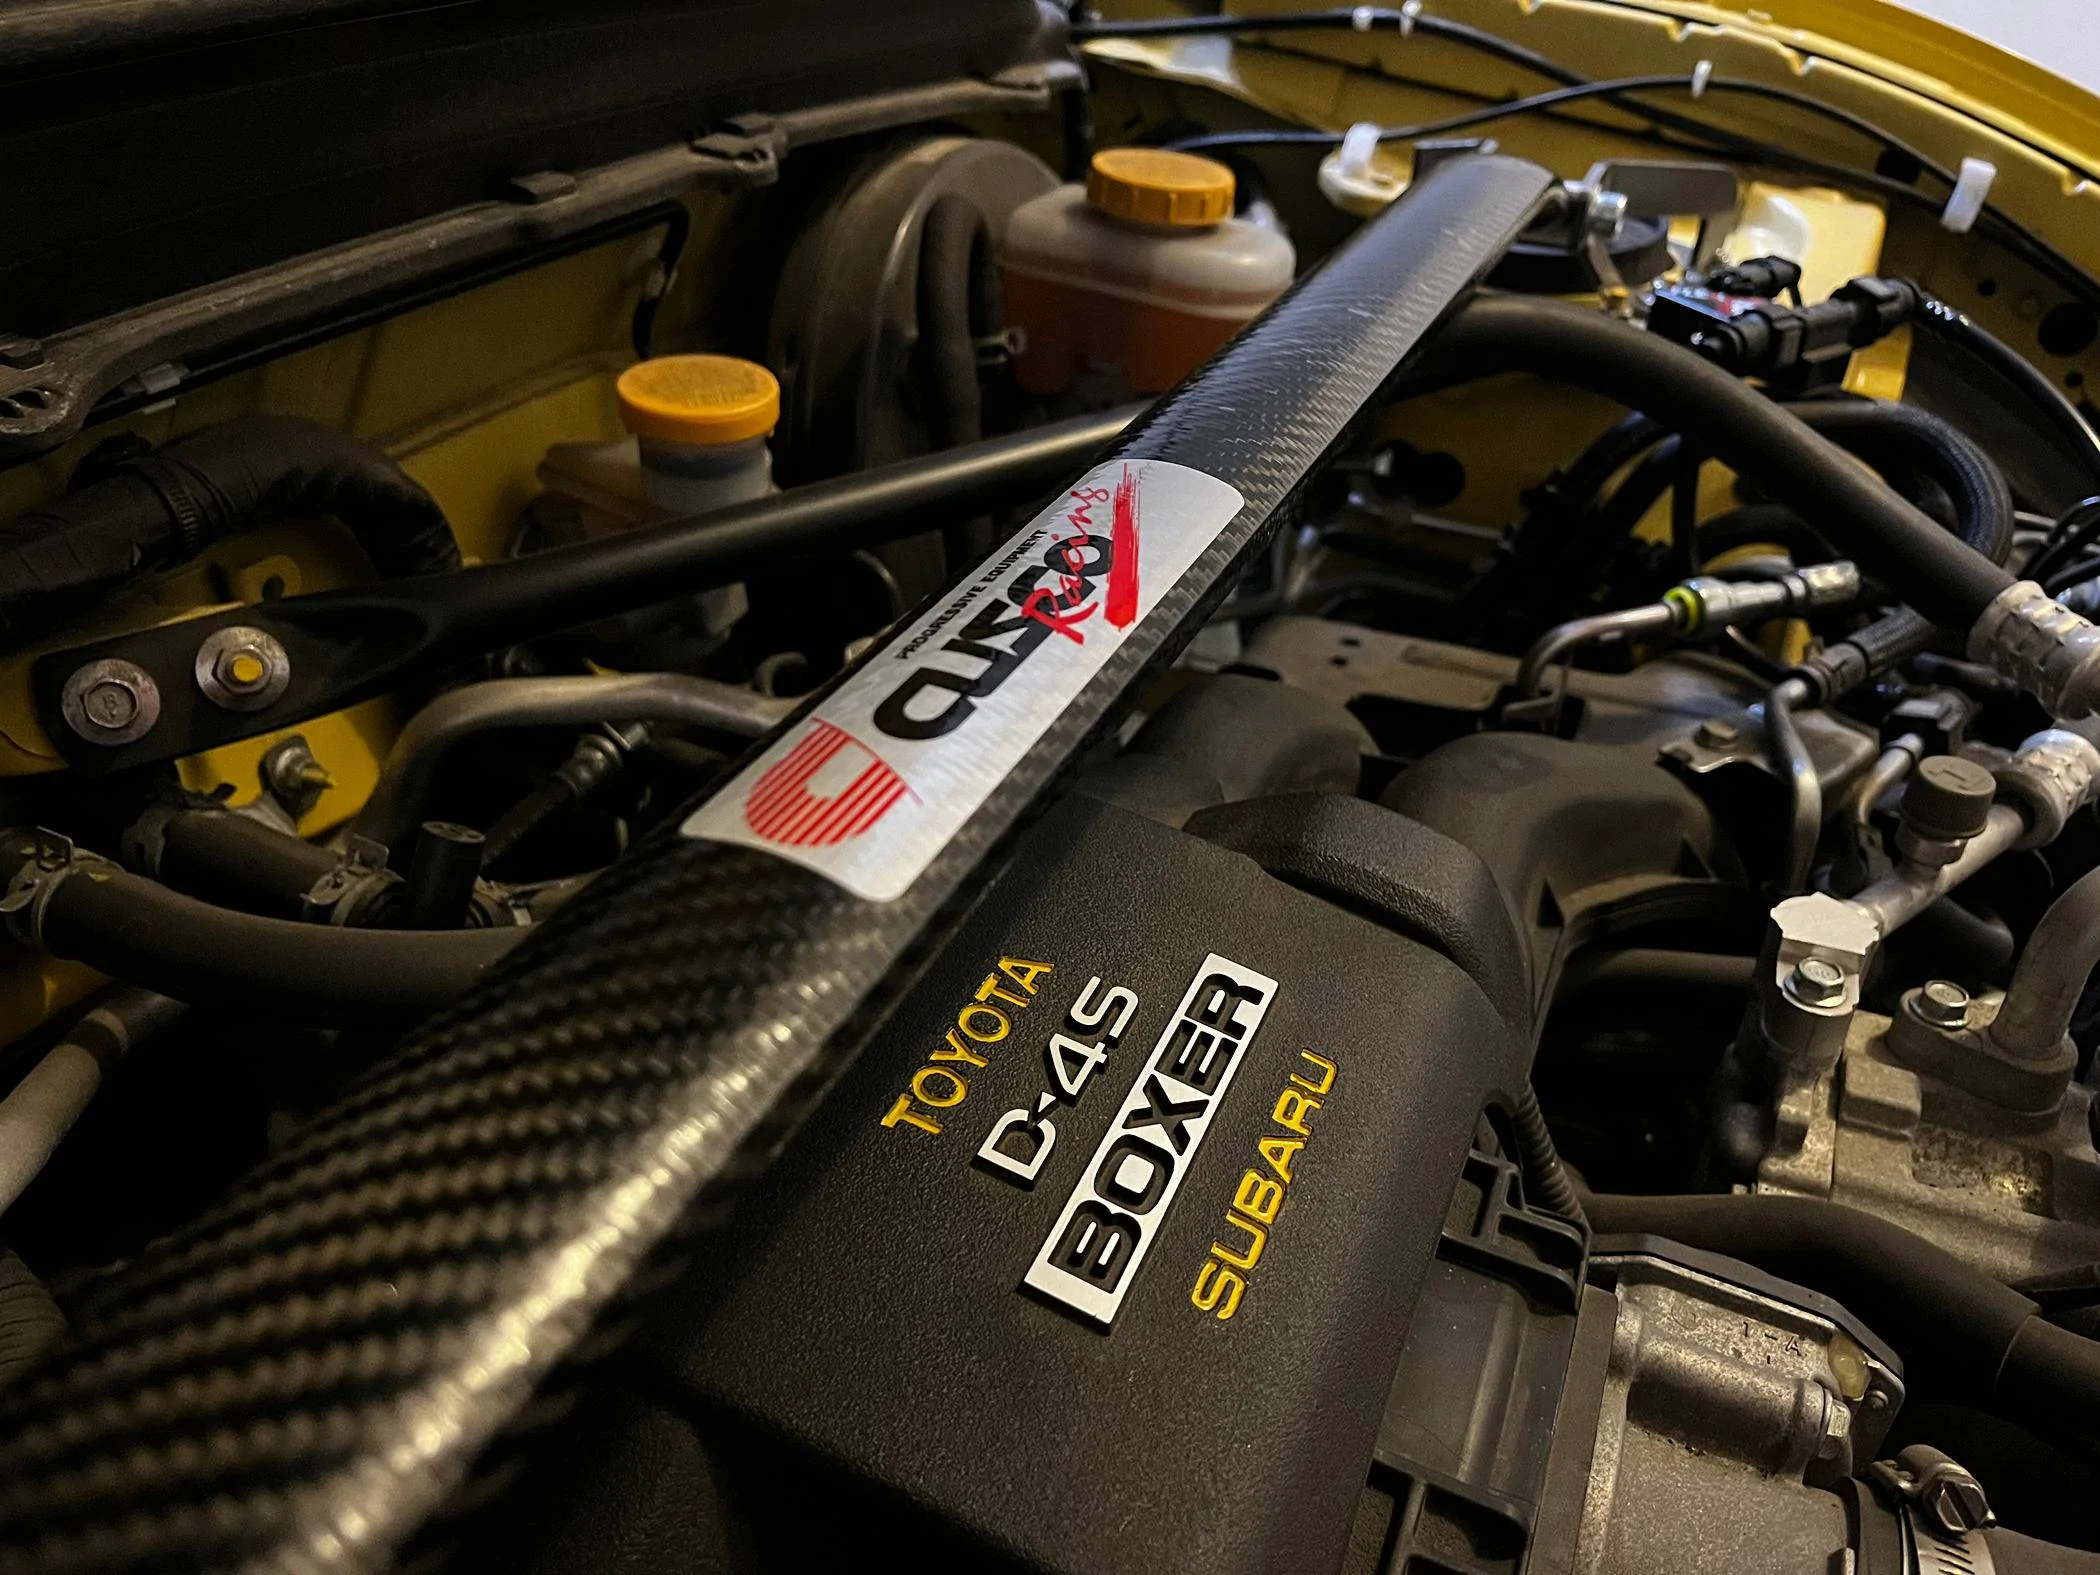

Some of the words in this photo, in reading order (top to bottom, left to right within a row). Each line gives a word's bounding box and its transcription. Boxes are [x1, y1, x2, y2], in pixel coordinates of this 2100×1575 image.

[895, 586, 987, 659] PROGRESSIVE
[980, 529, 1048, 583] EQUIPMENT
[1021, 486, 1110, 646] Racing
[881, 956, 1054, 1134] TOYOTA
[976, 976, 1139, 1181] D-4S
[1047, 972, 1266, 1294] BOXER
[1192, 1048, 1339, 1320] SUBARU
